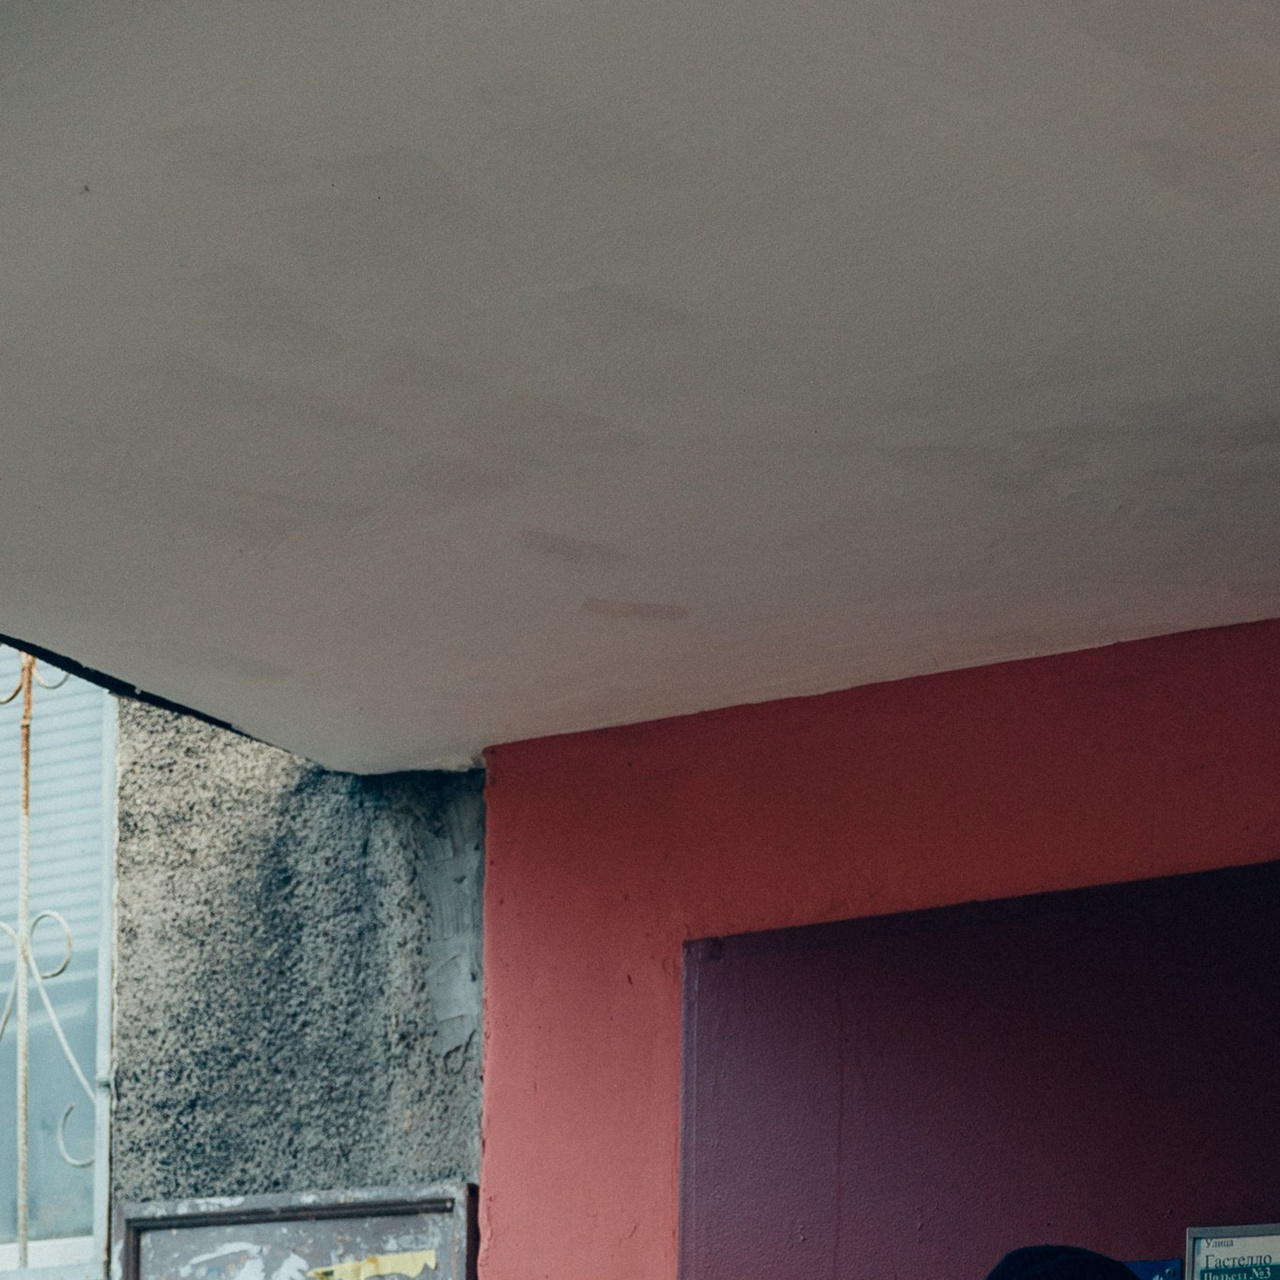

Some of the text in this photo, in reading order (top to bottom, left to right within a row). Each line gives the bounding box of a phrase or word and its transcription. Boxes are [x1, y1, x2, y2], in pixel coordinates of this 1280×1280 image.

[1205, 1239, 1233, 1249] Улица
[1205, 1254, 1272, 1269] Гастелло
[1250, 1267, 1271, 1280] №3
